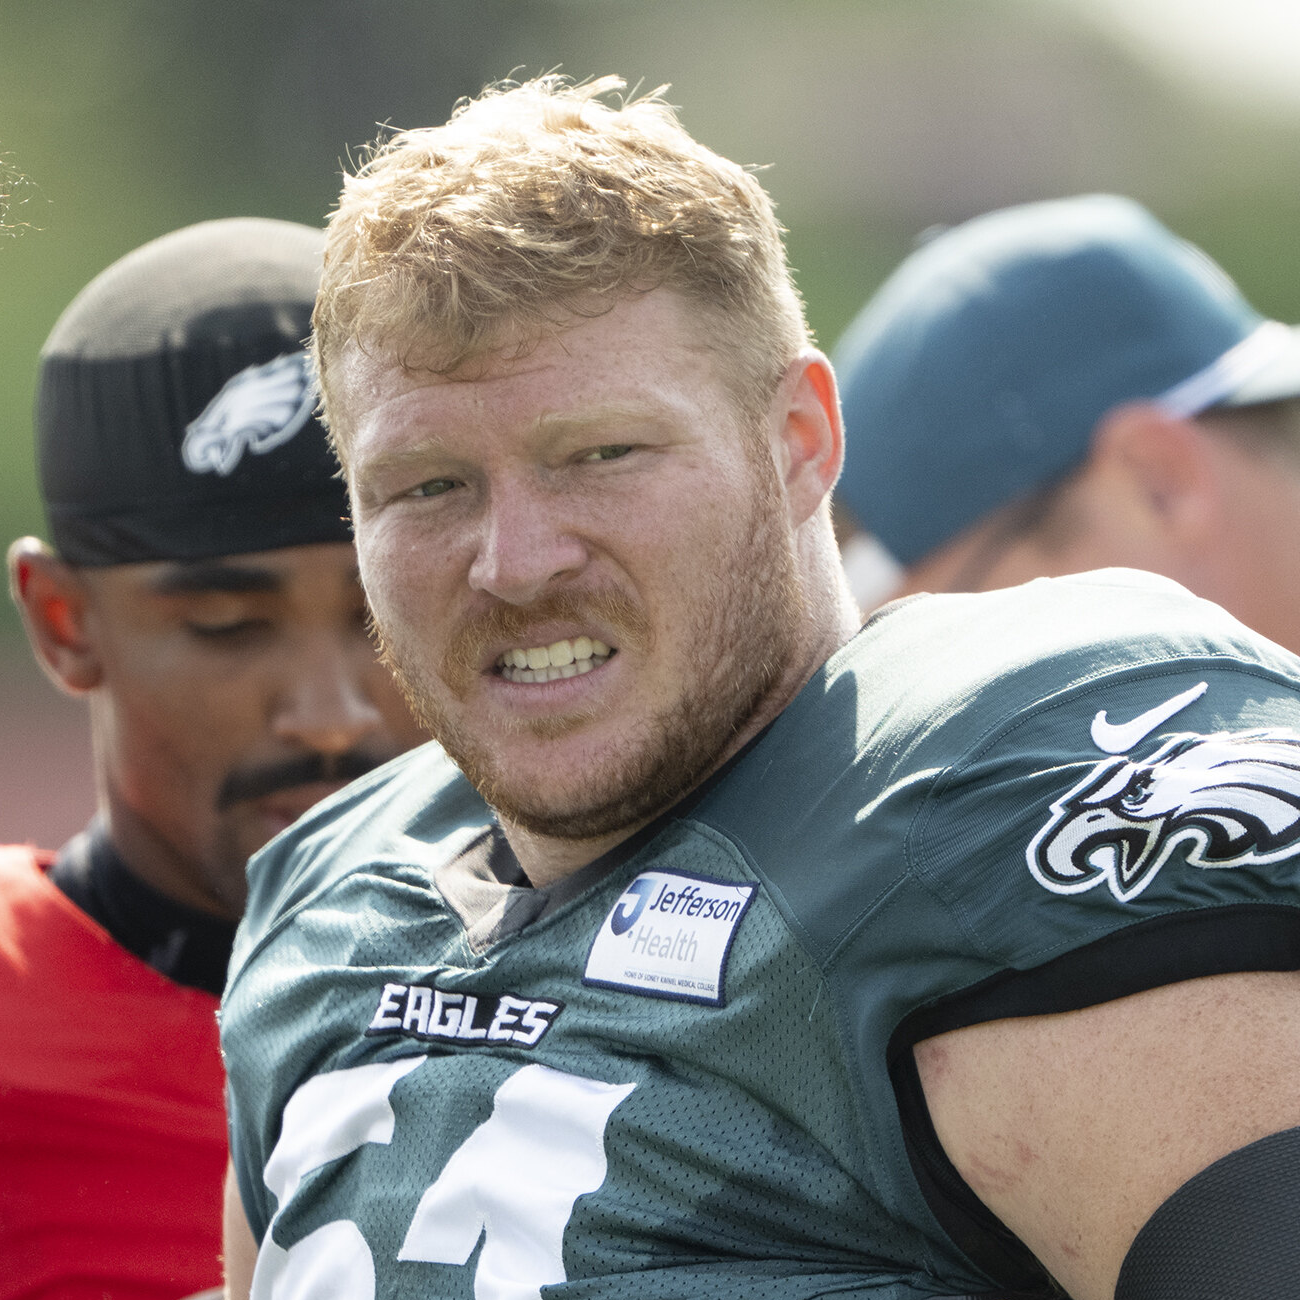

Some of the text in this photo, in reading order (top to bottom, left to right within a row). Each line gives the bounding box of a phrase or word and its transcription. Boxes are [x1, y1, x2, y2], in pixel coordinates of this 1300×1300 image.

[650, 883, 741, 922] Jefferson
[631, 925, 699, 963] Health
[368, 983, 559, 1045] EAGLES
